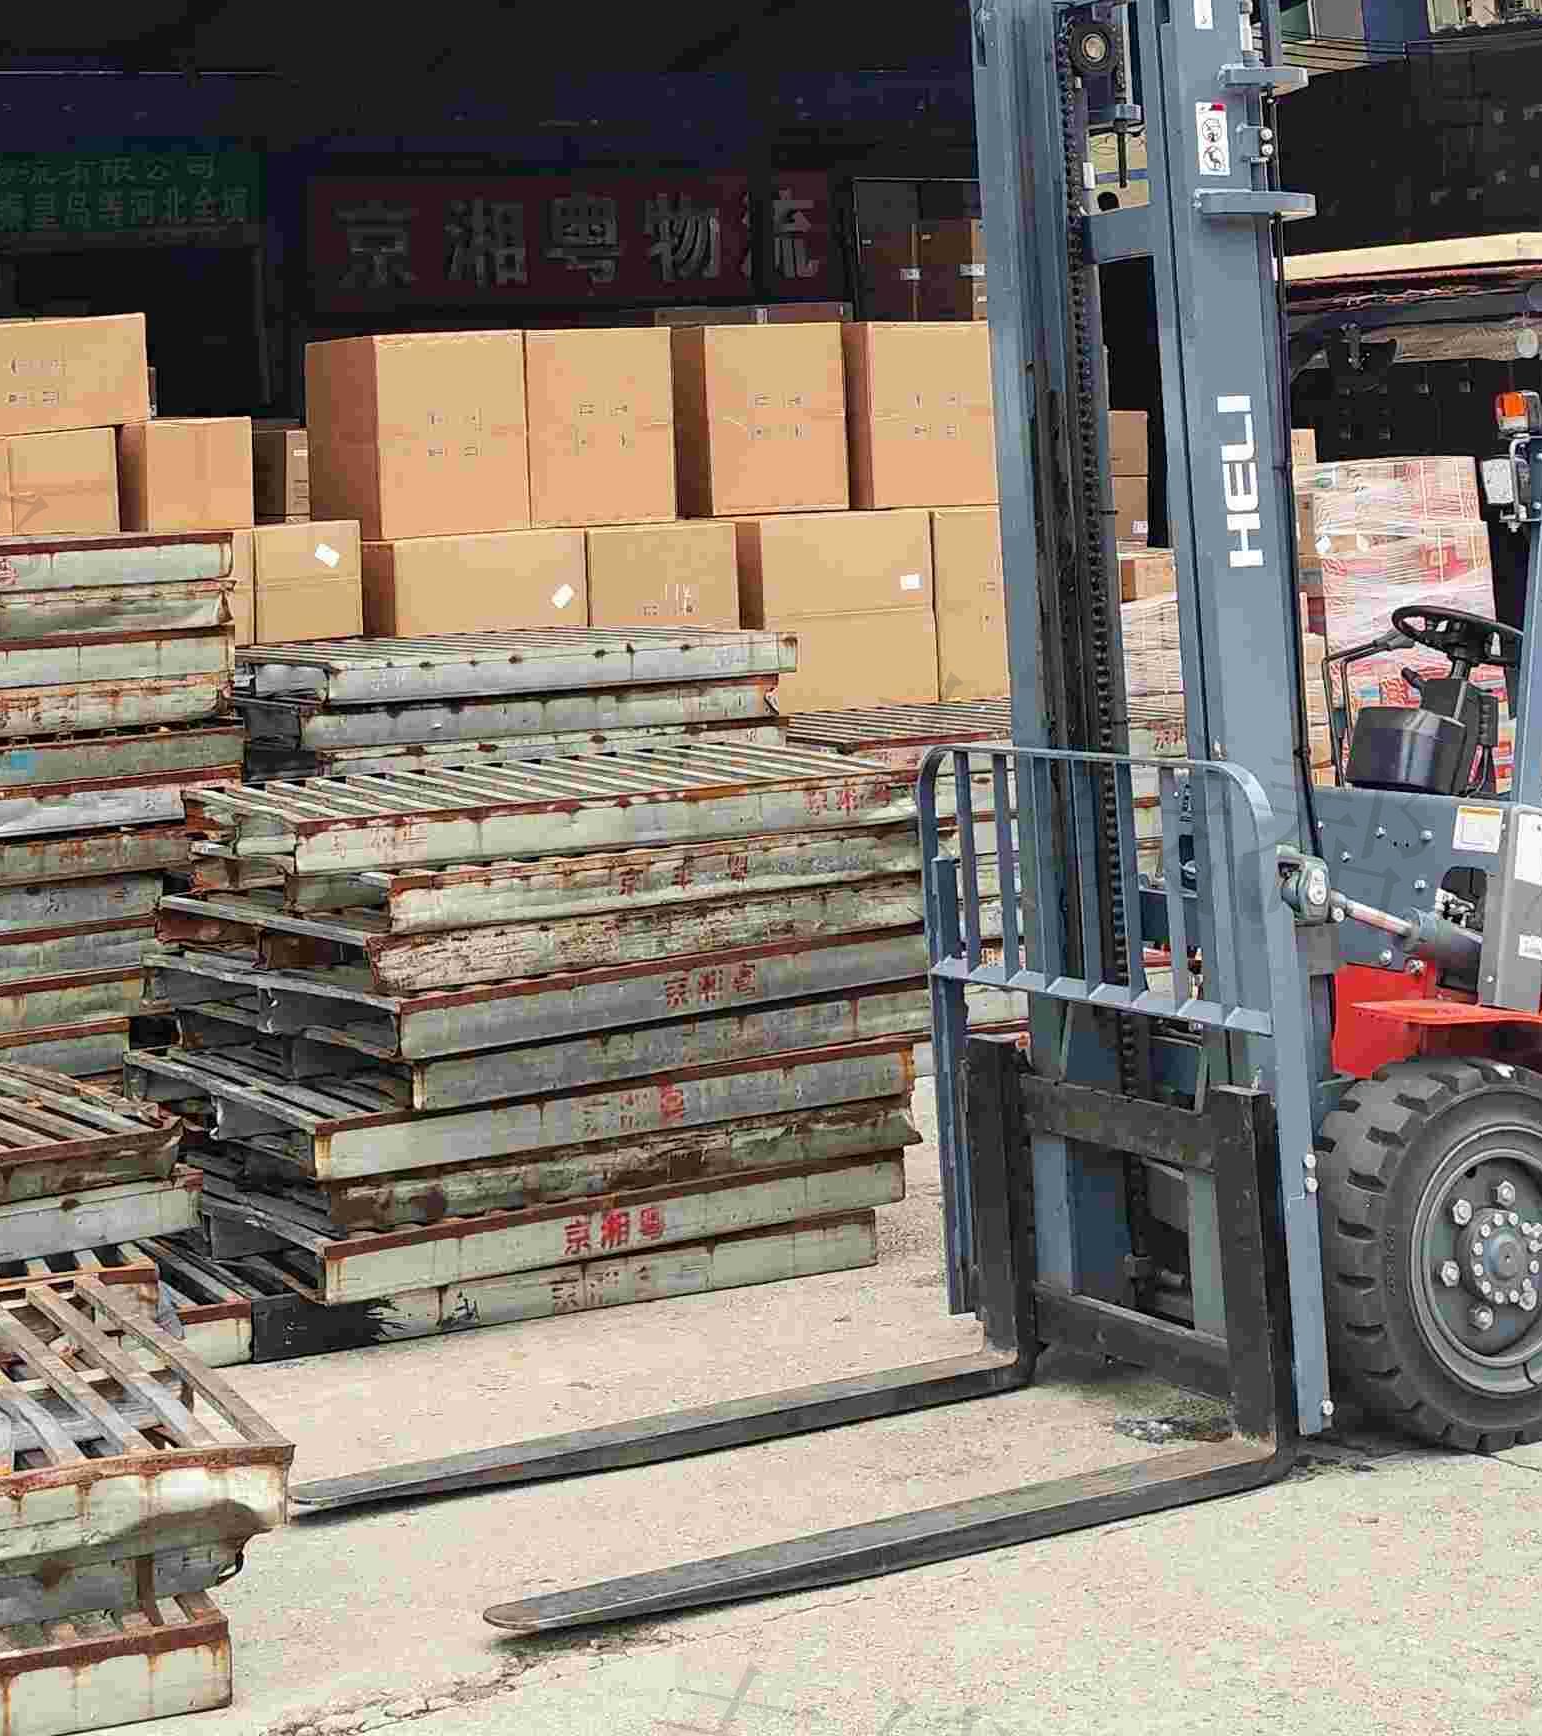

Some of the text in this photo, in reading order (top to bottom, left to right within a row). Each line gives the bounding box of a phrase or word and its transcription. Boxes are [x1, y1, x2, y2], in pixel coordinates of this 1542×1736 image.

[1217, 394, 1264, 567] HELI
[563, 1207, 666, 1255] 京湘粤
